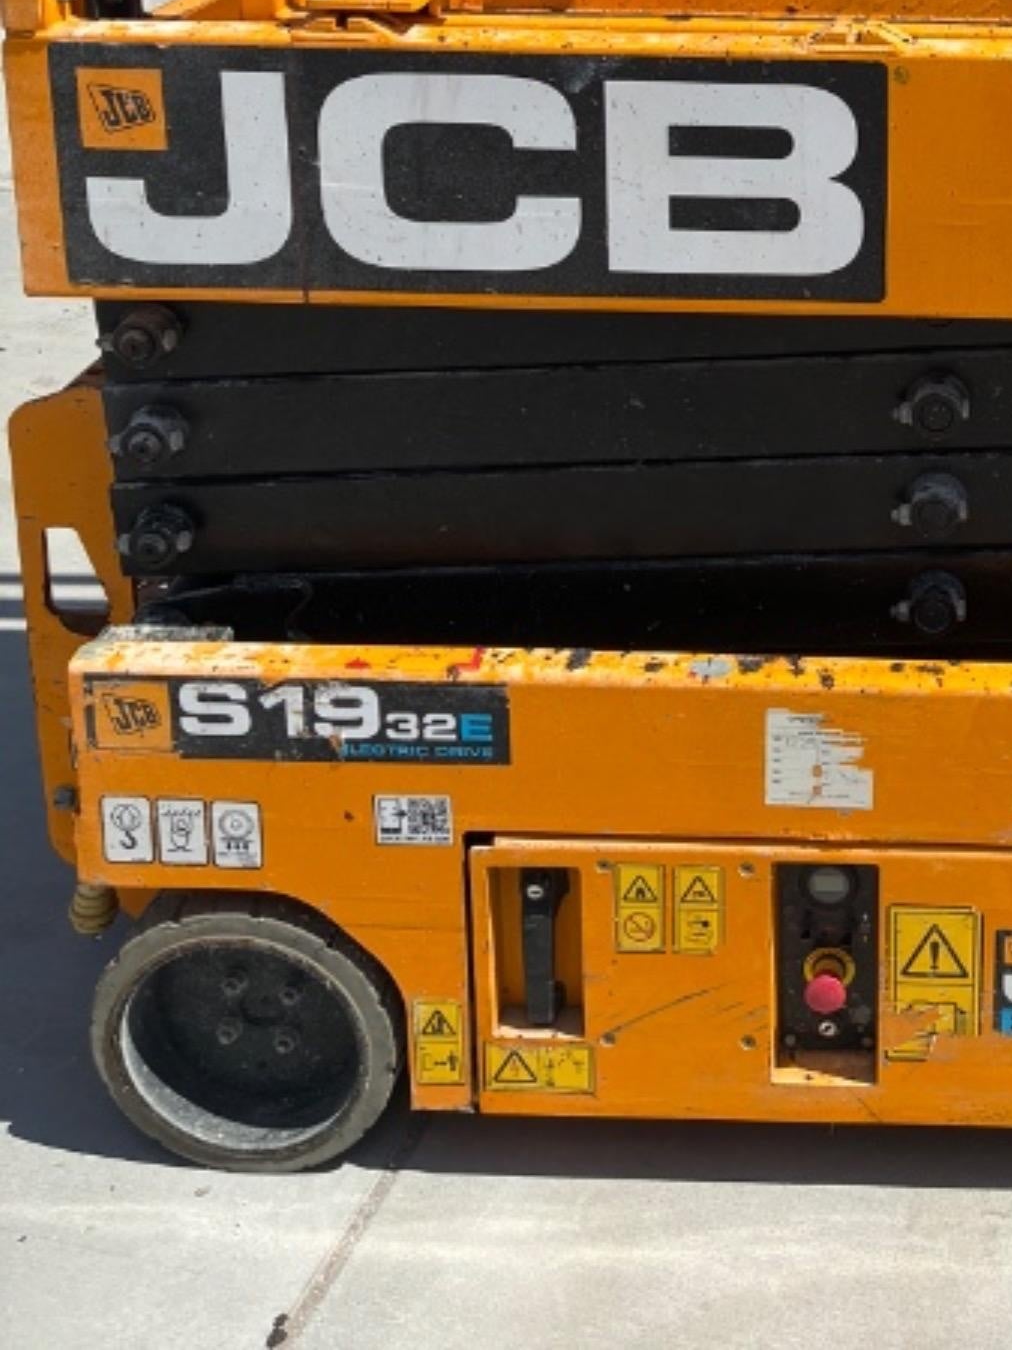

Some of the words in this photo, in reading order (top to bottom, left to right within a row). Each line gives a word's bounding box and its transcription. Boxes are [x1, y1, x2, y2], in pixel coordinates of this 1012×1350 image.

[98, 87, 156, 130] JCB
[86, 70, 866, 276] JCB
[111, 697, 163, 736] JCB
